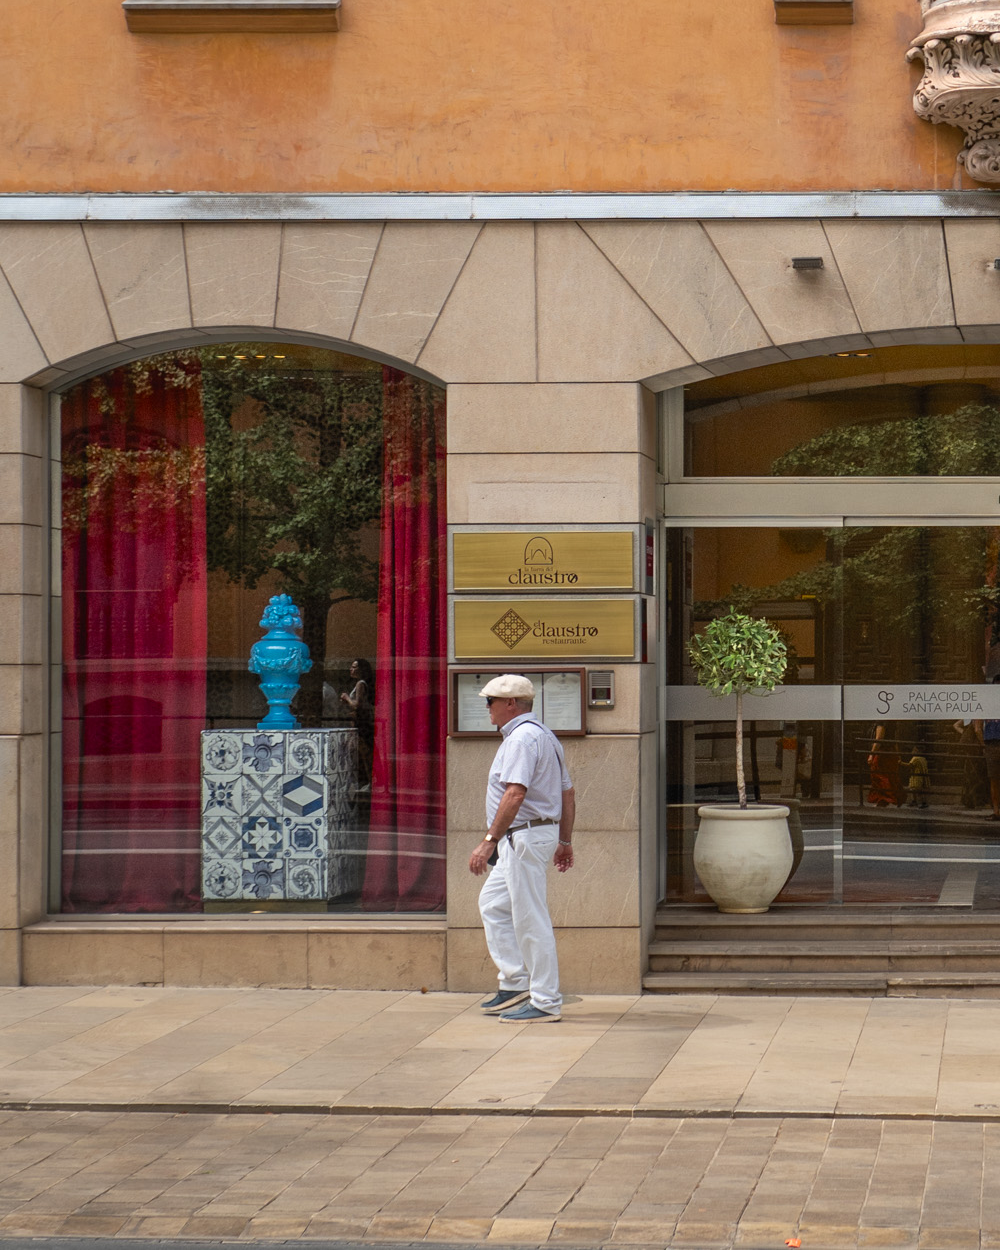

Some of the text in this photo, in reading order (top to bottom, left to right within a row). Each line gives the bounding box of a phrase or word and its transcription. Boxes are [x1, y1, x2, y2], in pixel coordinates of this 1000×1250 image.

[908, 691, 978, 702] PALACIO DE
[902, 702, 984, 713] SANTA PAULA
